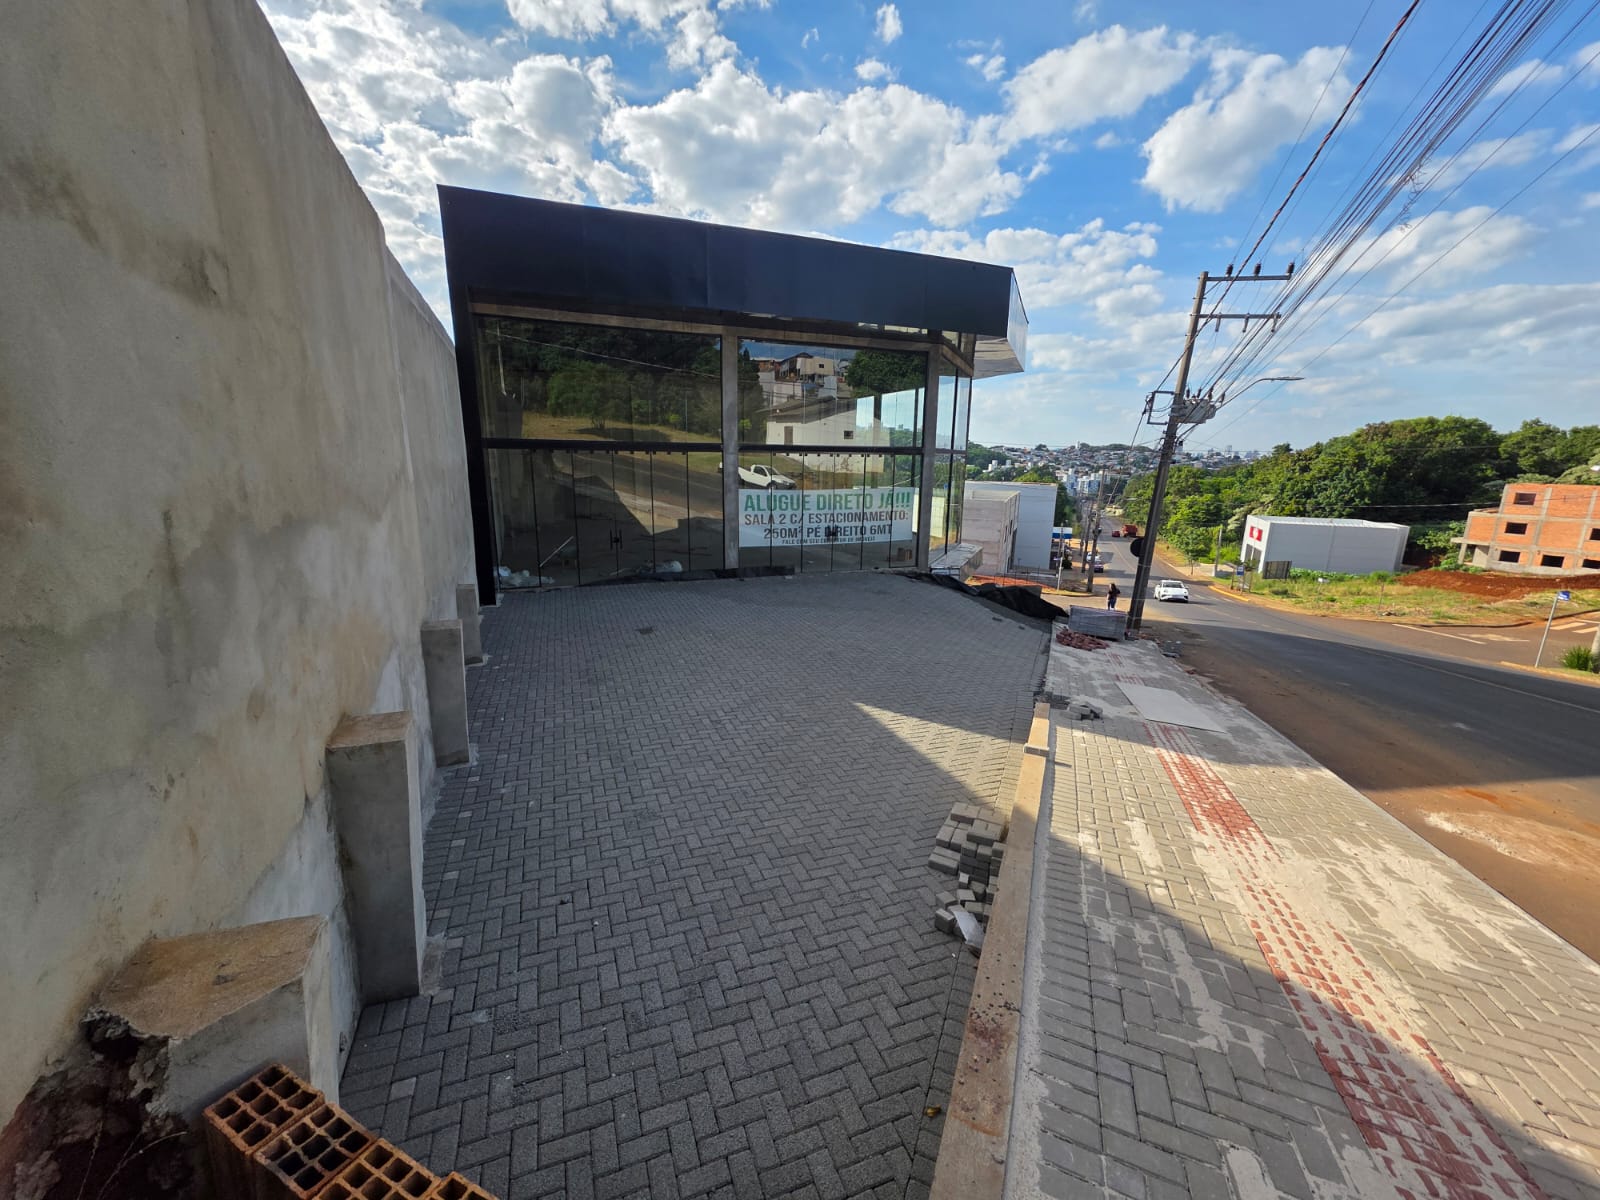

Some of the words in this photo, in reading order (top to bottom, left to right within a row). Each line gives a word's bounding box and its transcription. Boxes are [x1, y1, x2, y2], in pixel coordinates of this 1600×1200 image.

[744, 494, 811, 511] ALUGUE
[816, 493, 873, 510] DIRETO
[744, 513, 775, 525] SALA
[779, 513, 786, 524] 2
[790, 513, 803, 524] C/
[809, 510, 908, 524] ESTACIONAMENTO:
[807, 525, 821, 538] PÉ
[824, 524, 867, 537] DREITO
[870, 523, 892, 535] 6MT
